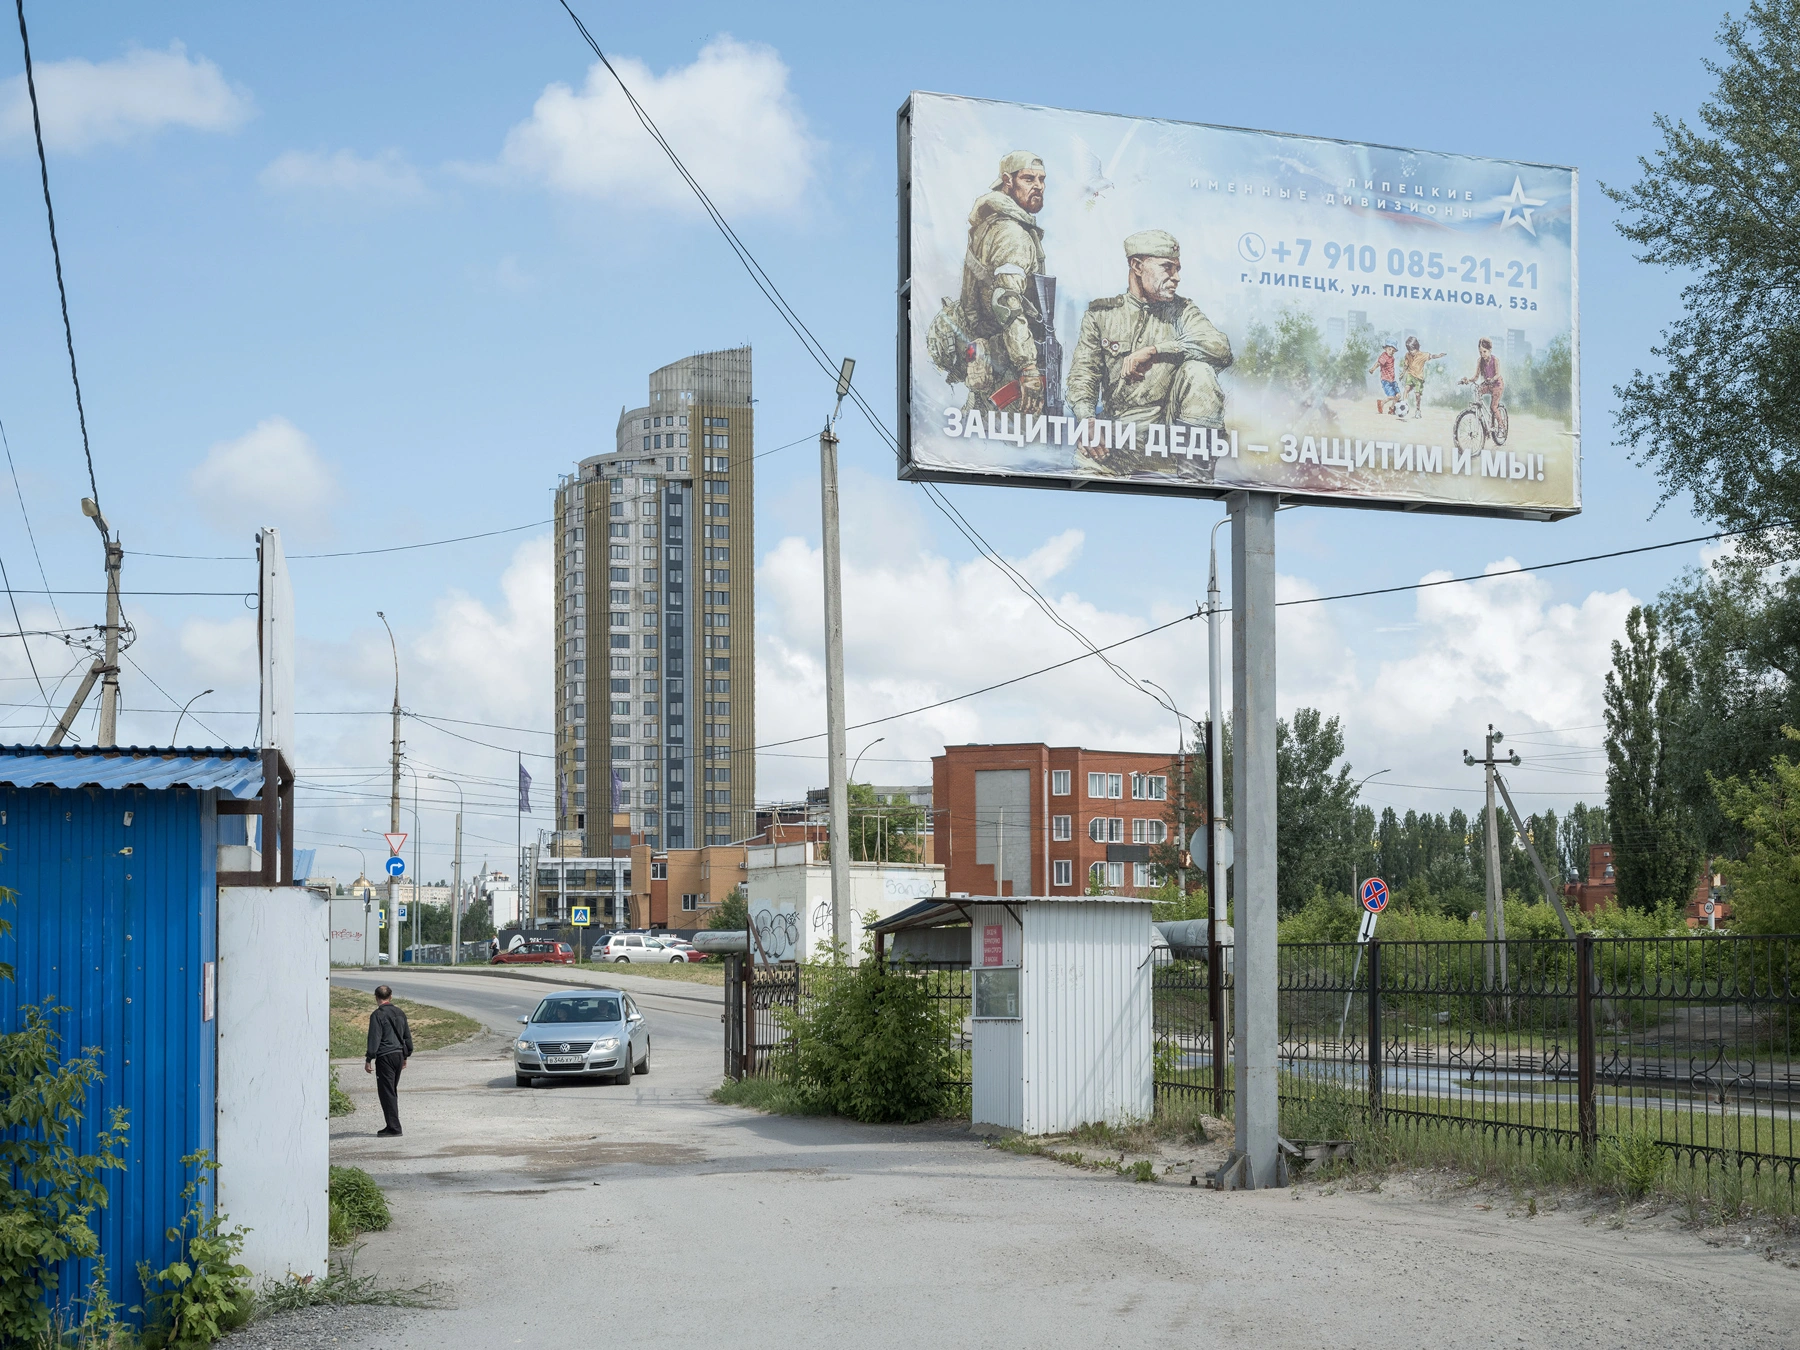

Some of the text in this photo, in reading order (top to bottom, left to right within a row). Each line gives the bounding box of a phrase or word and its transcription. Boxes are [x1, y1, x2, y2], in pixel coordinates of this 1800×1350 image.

[1190, 178, 1472, 218] ИМЕННЫЕ ДИВИЗИОНЫ
[1346, 178, 1473, 201] ЛИПЕЦКИЕ
[1271, 238, 1538, 290] +7 910 085-21-21
[1241, 271, 1538, 311] г. ЛИПЕЦК, ул. ПЛЕХАНОВА, 53а
[943, 406, 1136, 451] ЗАЩИТИЛИ
[1145, 423, 1238, 460] ДЕДЫ
[1279, 433, 1443, 474] ЗАЩИТИМ
[1452, 446, 1473, 475] И
[1480, 449, 1545, 482] МЫ!
